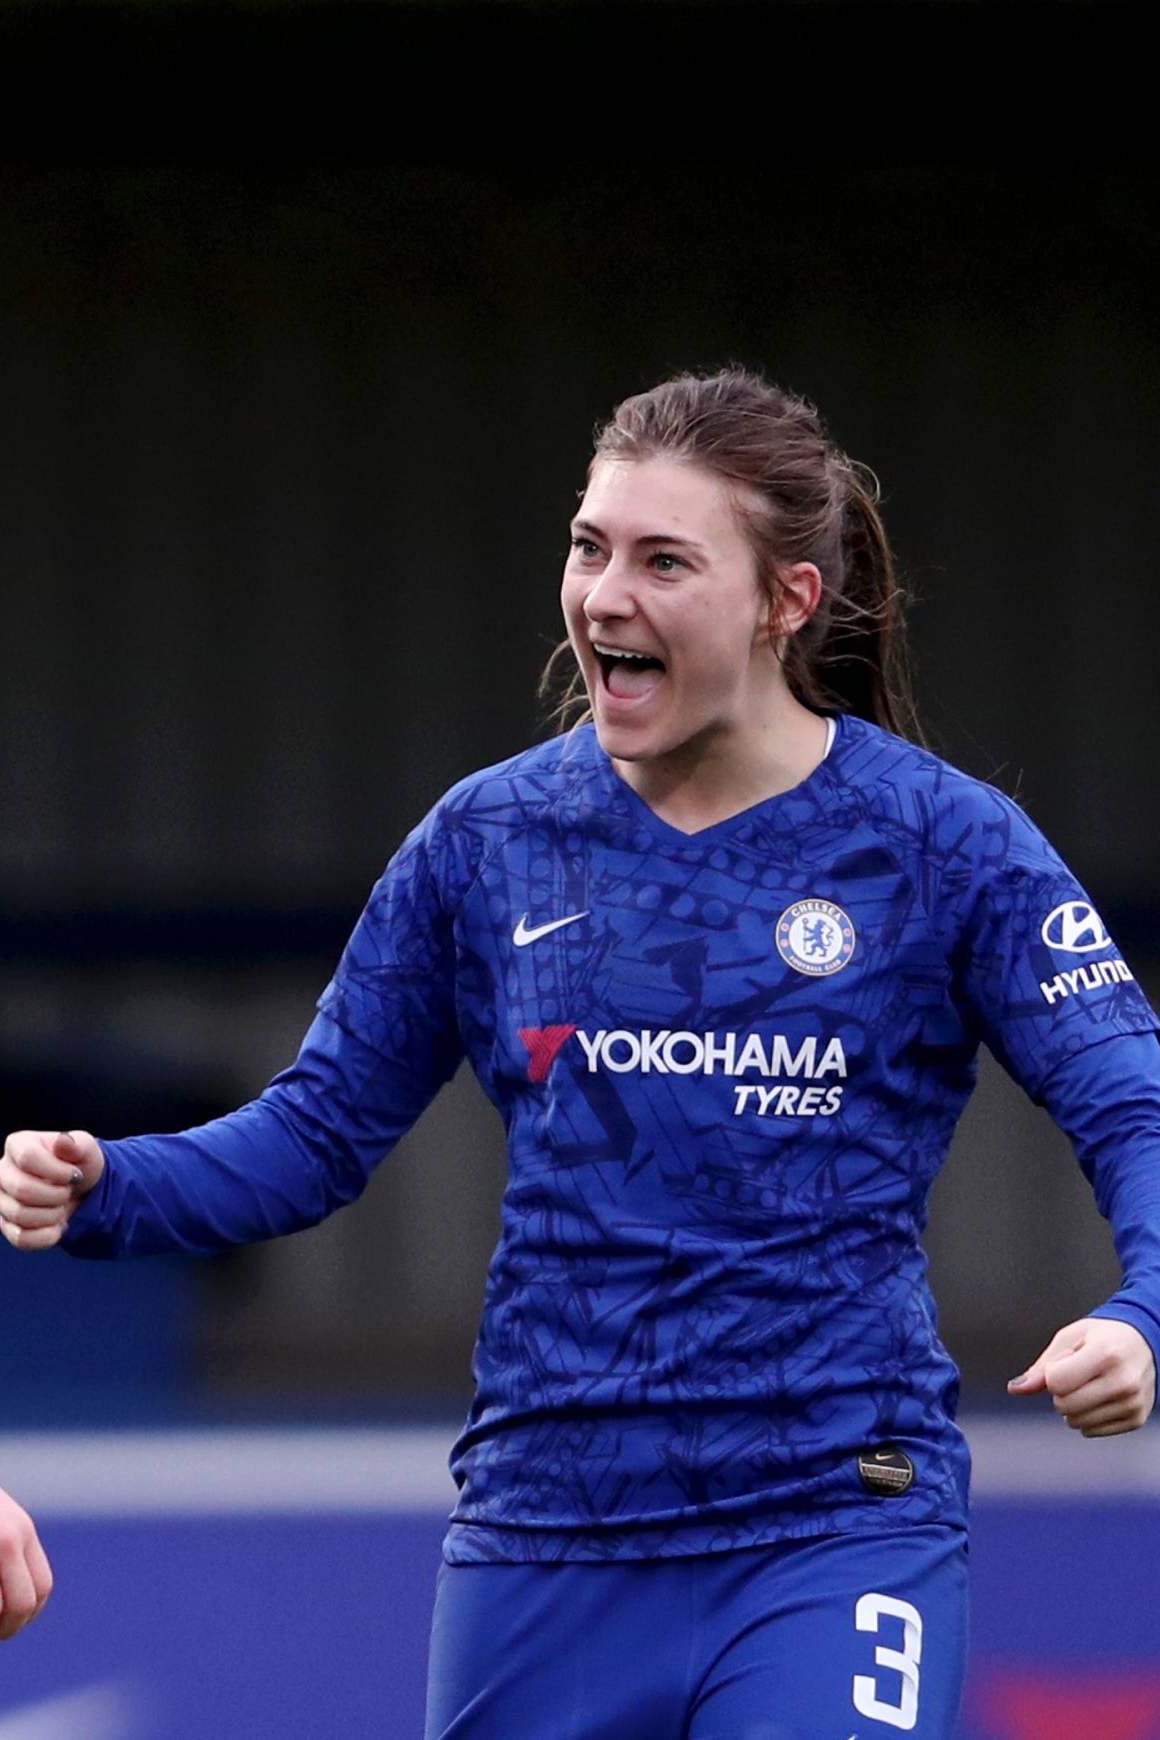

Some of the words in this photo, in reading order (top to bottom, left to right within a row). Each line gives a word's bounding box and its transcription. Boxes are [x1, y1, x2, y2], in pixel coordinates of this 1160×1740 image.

[791, 902, 842, 921] CHELSEA
[576, 1029, 848, 1078] YOKOHAMA
[733, 1086, 844, 1117] TYRES
[852, 1592, 923, 1731] 3
